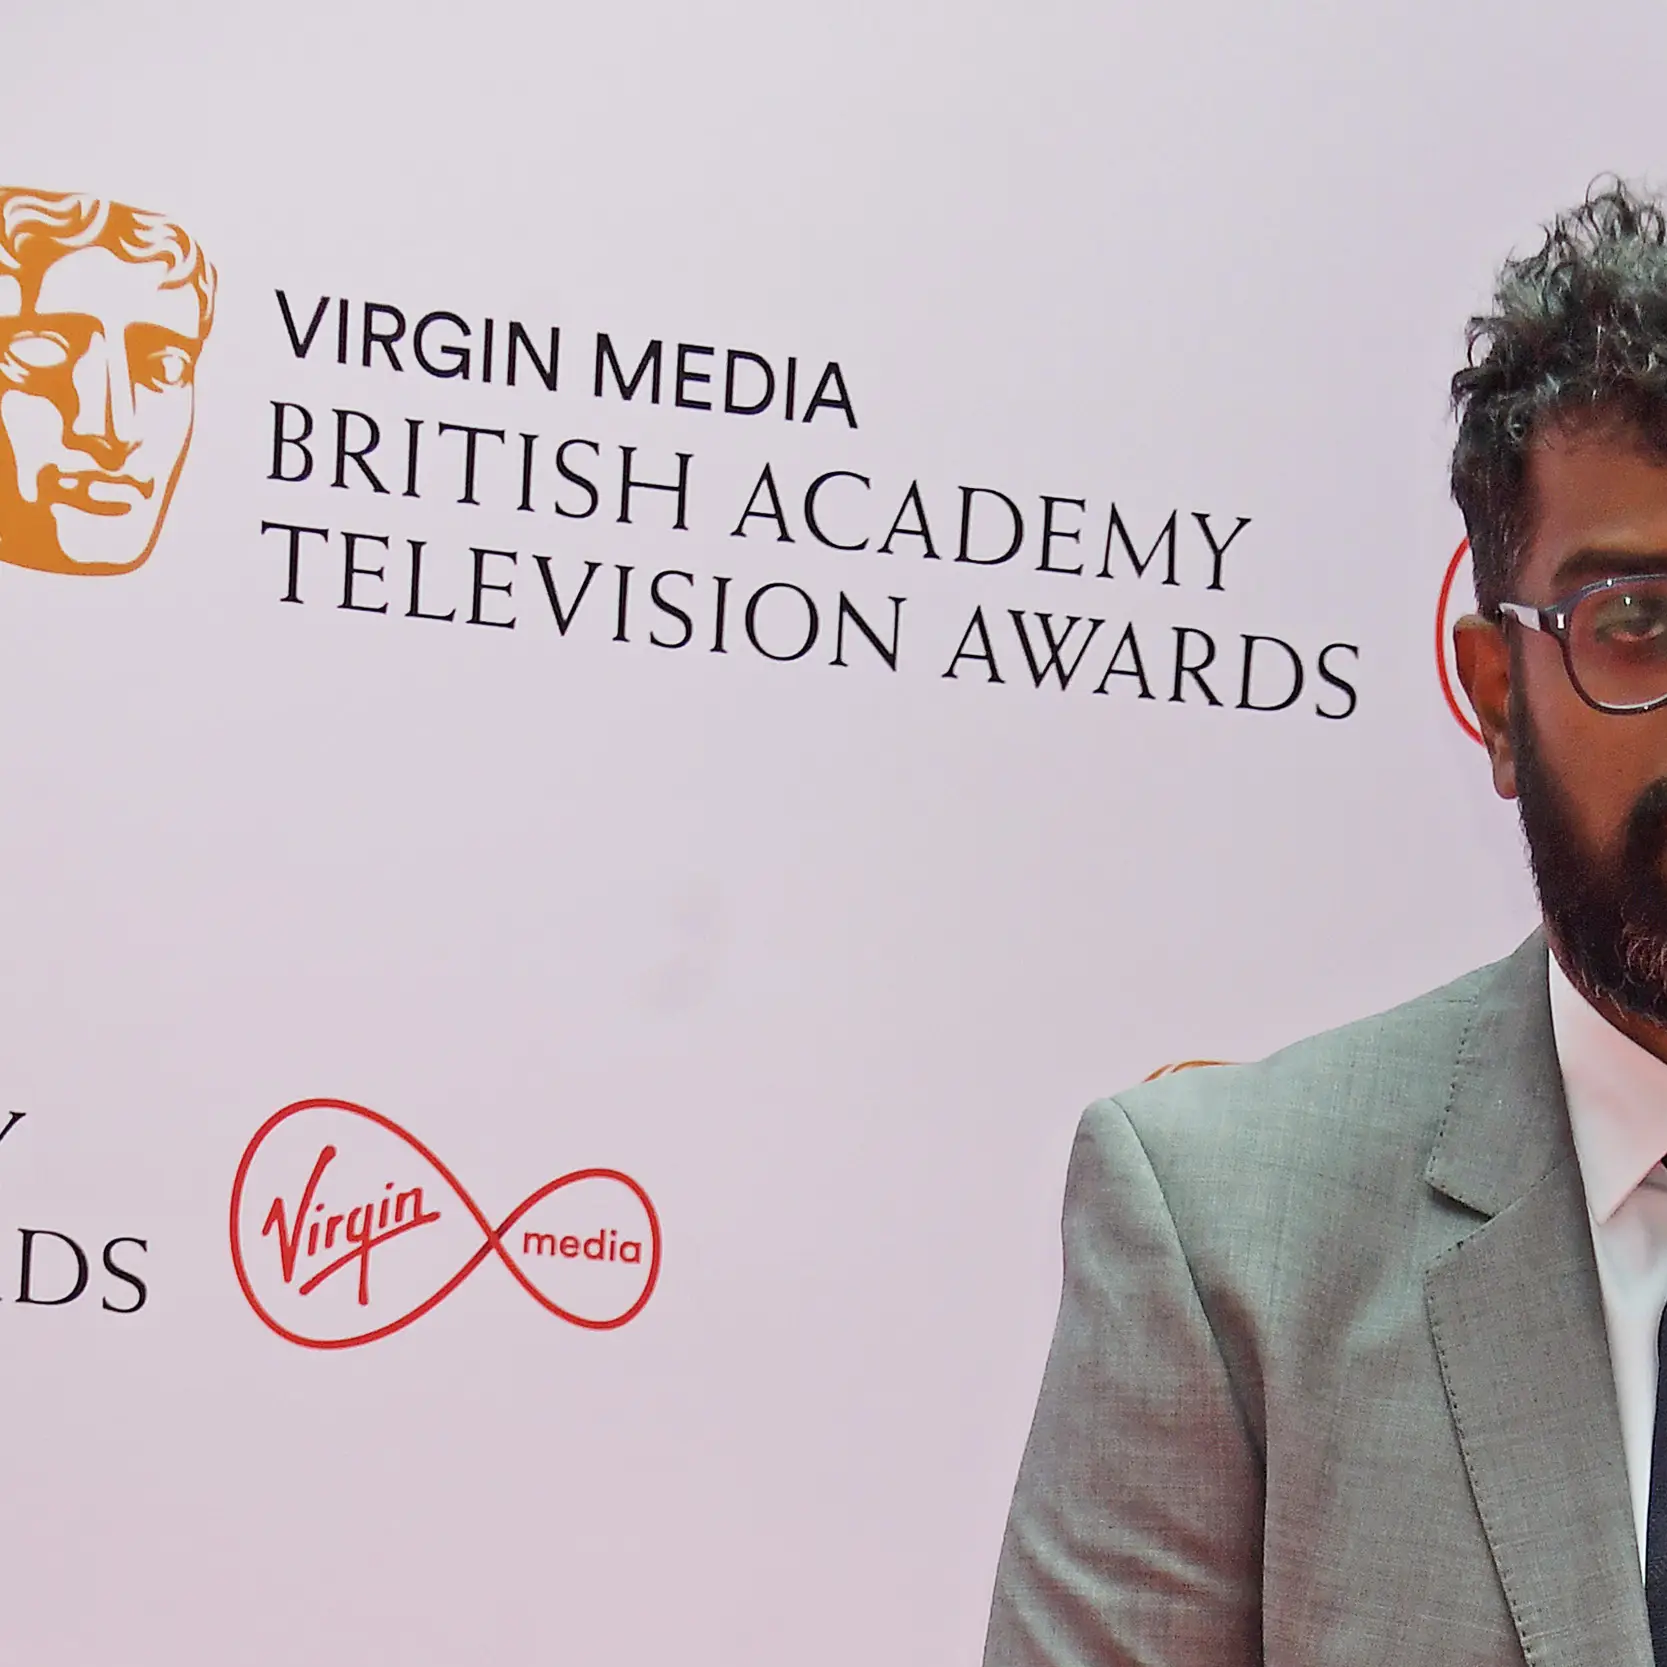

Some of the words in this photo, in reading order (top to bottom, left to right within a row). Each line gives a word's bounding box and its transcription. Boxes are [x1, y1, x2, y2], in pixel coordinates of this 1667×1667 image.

[275, 289, 560, 392] VIRGIN
[594, 332, 858, 429] MEDIA
[267, 400, 694, 531] BRITISH
[730, 462, 1252, 591] ACADEMY
[261, 520, 907, 672] TELEVISION
[941, 605, 1359, 719] AWARDS
[261, 1145, 441, 1306] Virgin
[523, 1228, 642, 1264] media
